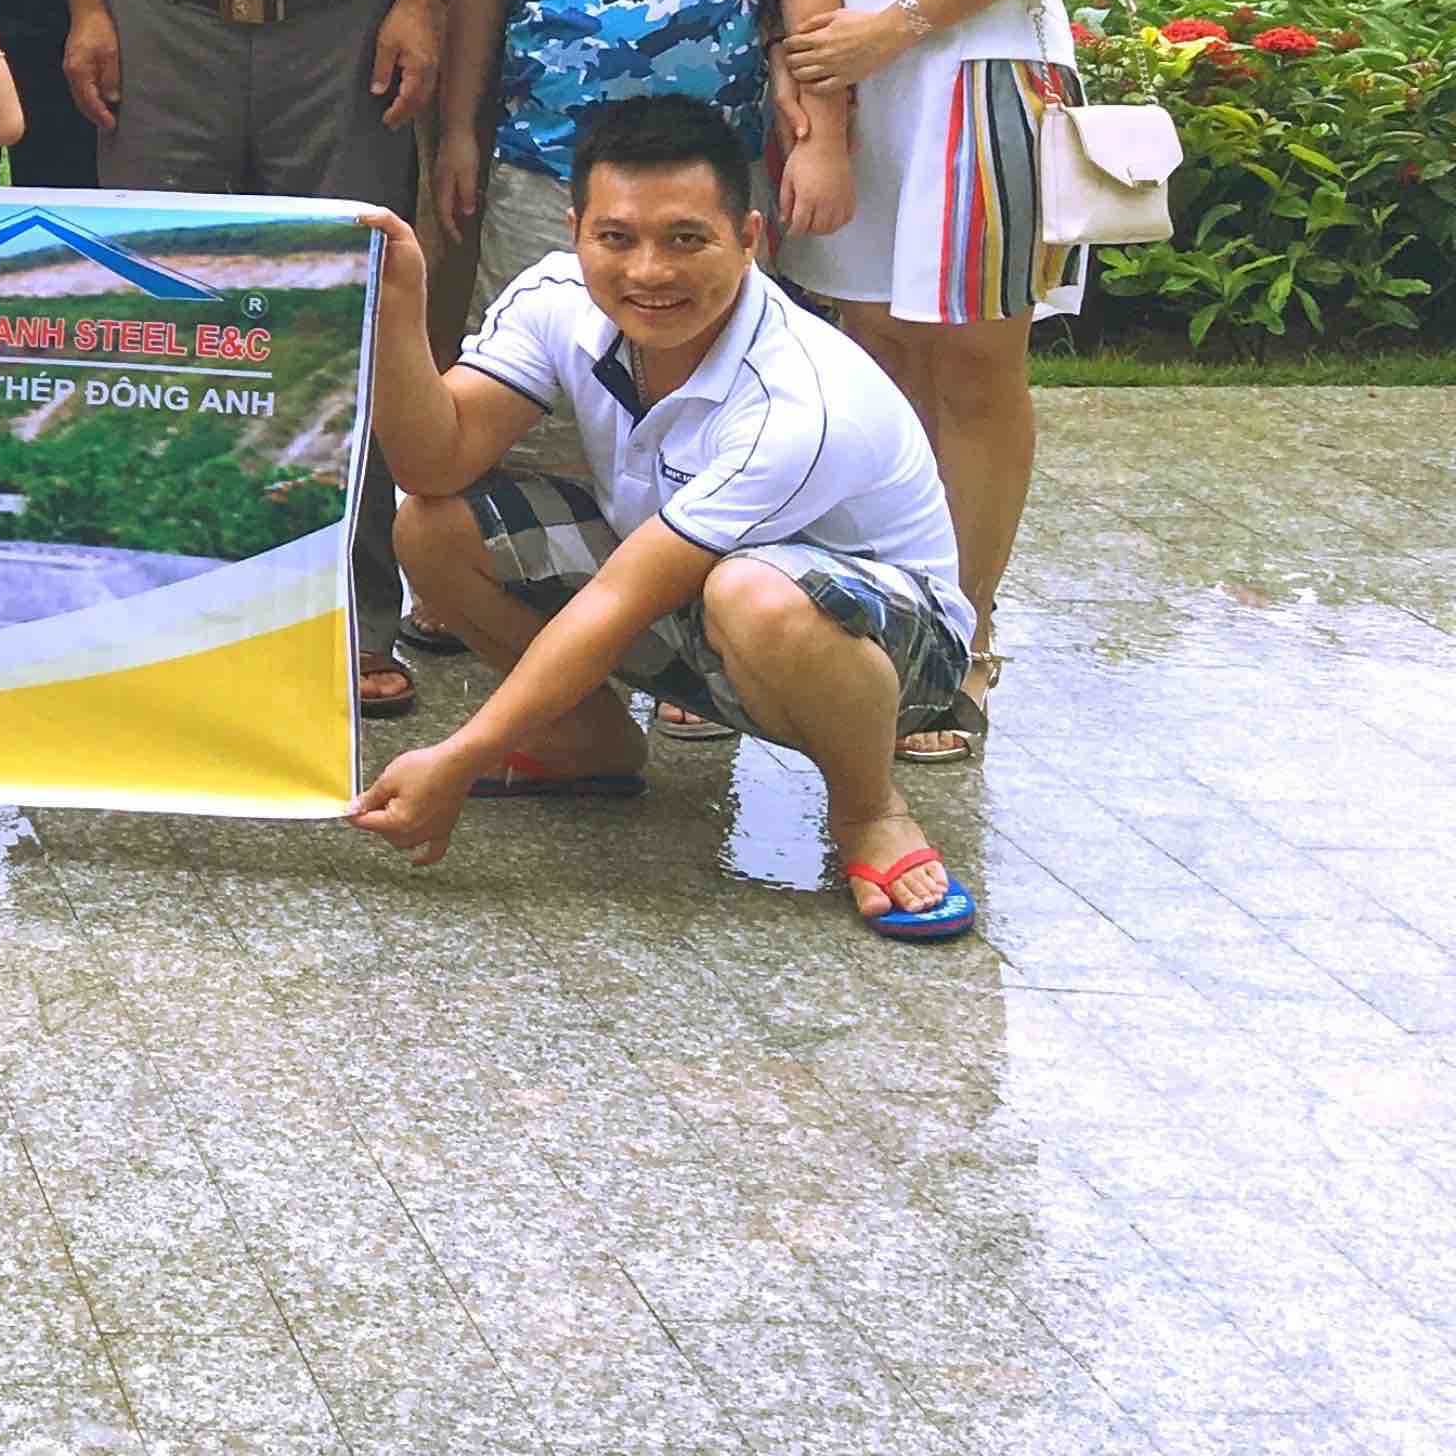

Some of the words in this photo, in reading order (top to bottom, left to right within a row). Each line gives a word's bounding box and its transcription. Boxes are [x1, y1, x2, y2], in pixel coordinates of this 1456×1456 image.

[74, 320, 187, 356] STEEL
[195, 325, 272, 362] E&C
[85, 376, 189, 411] ĐÔNG
[198, 388, 275, 417] ANH
